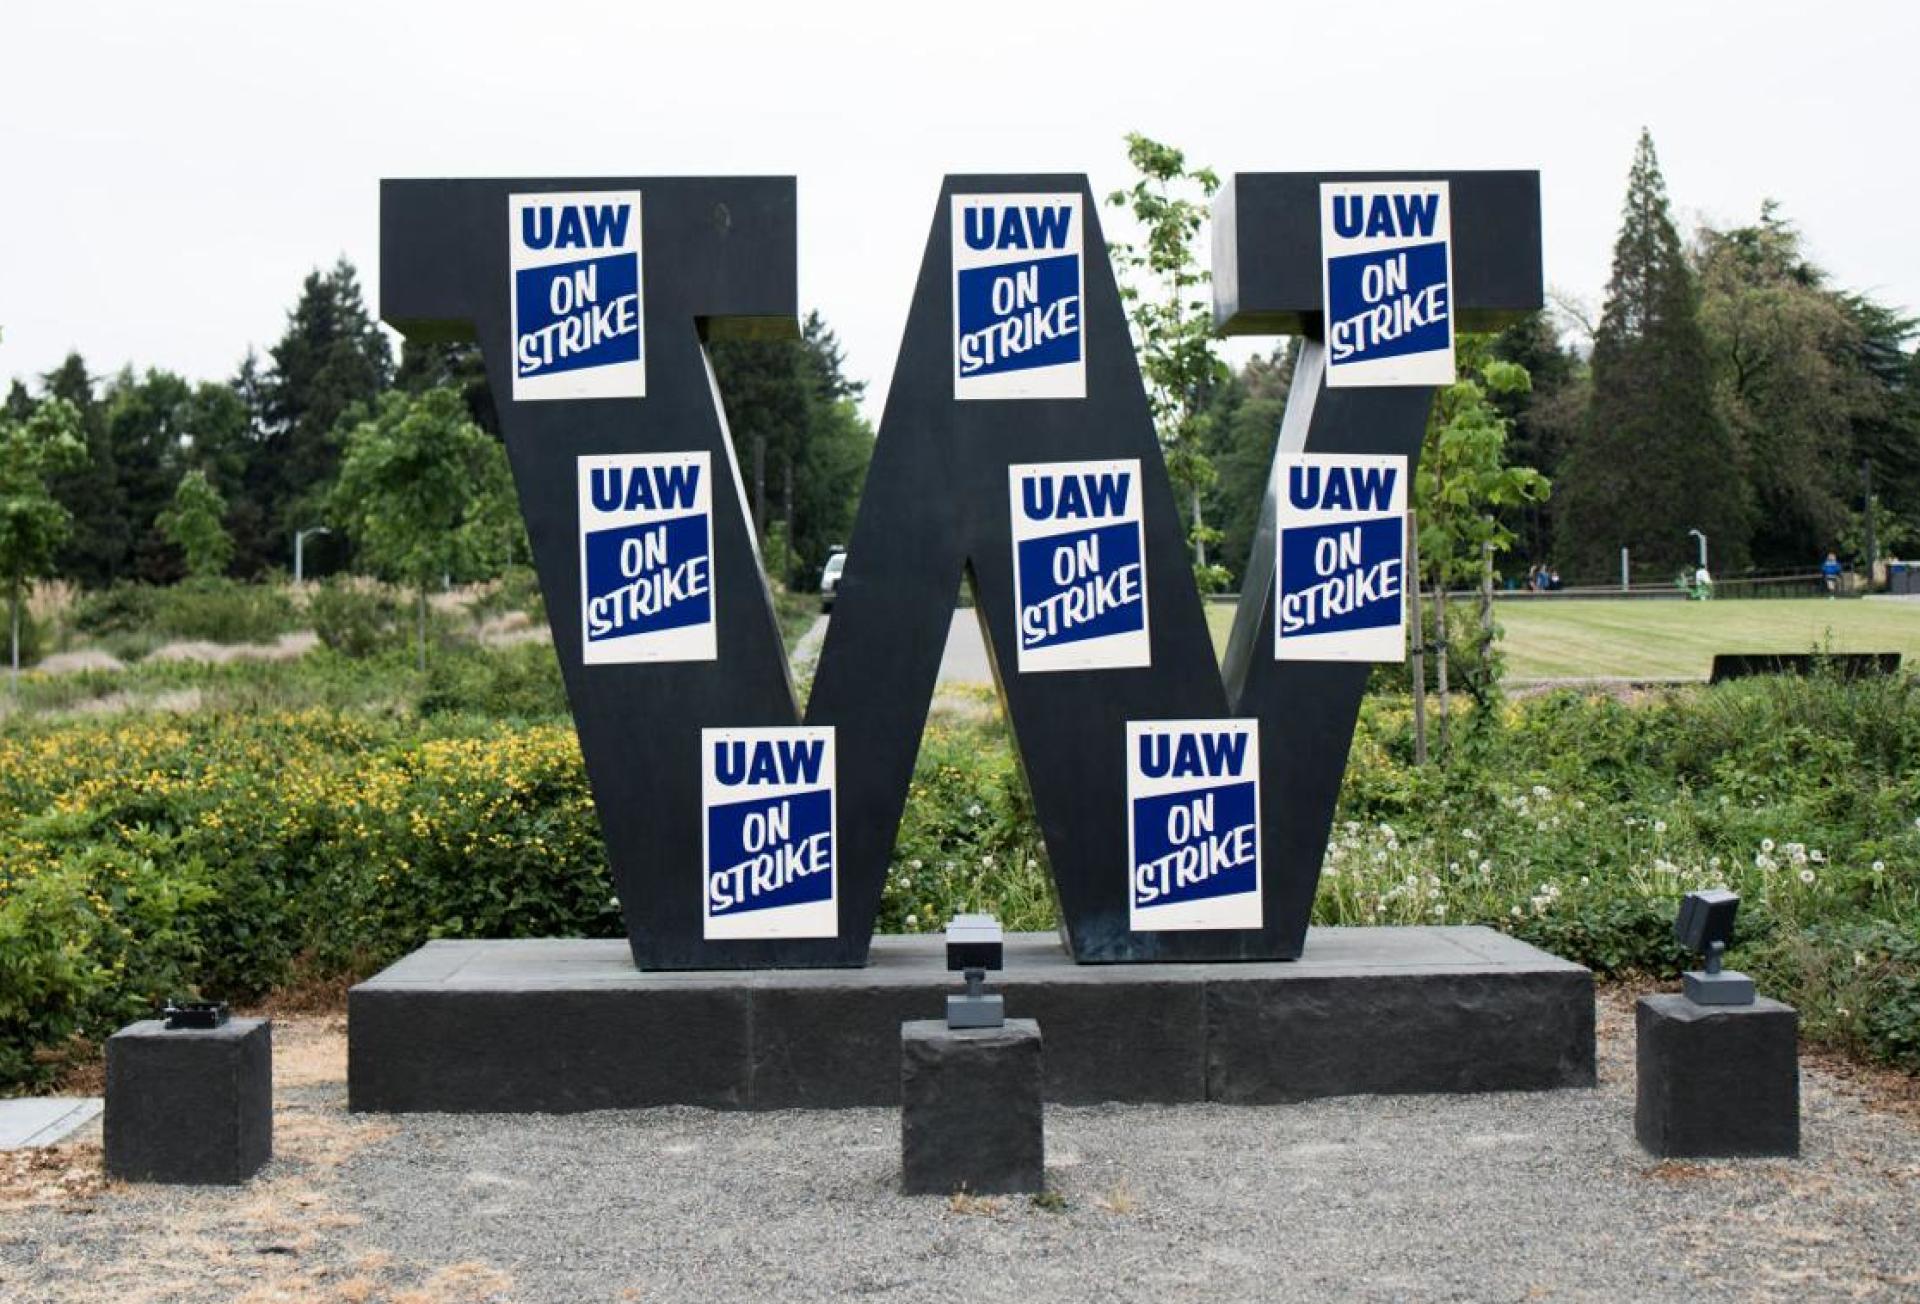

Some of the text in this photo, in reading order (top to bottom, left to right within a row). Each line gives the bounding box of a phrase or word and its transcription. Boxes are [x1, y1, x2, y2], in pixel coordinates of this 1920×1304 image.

[522, 204, 631, 250] UAW
[964, 206, 1073, 250] UAW
[1333, 193, 1440, 238] UAW
[550, 264, 597, 315] ON
[992, 265, 1039, 315] ON
[1361, 253, 1408, 303] ON
[518, 293, 638, 372] STRIKE
[961, 294, 1079, 372] STRIKE
[1331, 283, 1448, 360] STRIKE
[591, 464, 700, 511] UAW
[1023, 473, 1130, 520] UAW
[1290, 466, 1397, 511] UAW
[620, 526, 667, 577] ON
[1052, 534, 1100, 585] ON
[1315, 527, 1362, 576] ON
[588, 555, 708, 636] STRIKE
[1022, 564, 1141, 643] STRIKE
[1282, 558, 1400, 634] STRIKE
[715, 741, 823, 785] UAW
[1140, 733, 1247, 778] UAW
[742, 801, 790, 852] ON
[1167, 793, 1214, 844] ON
[711, 831, 830, 911] STRIKE
[1136, 824, 1255, 903] STRIKE
